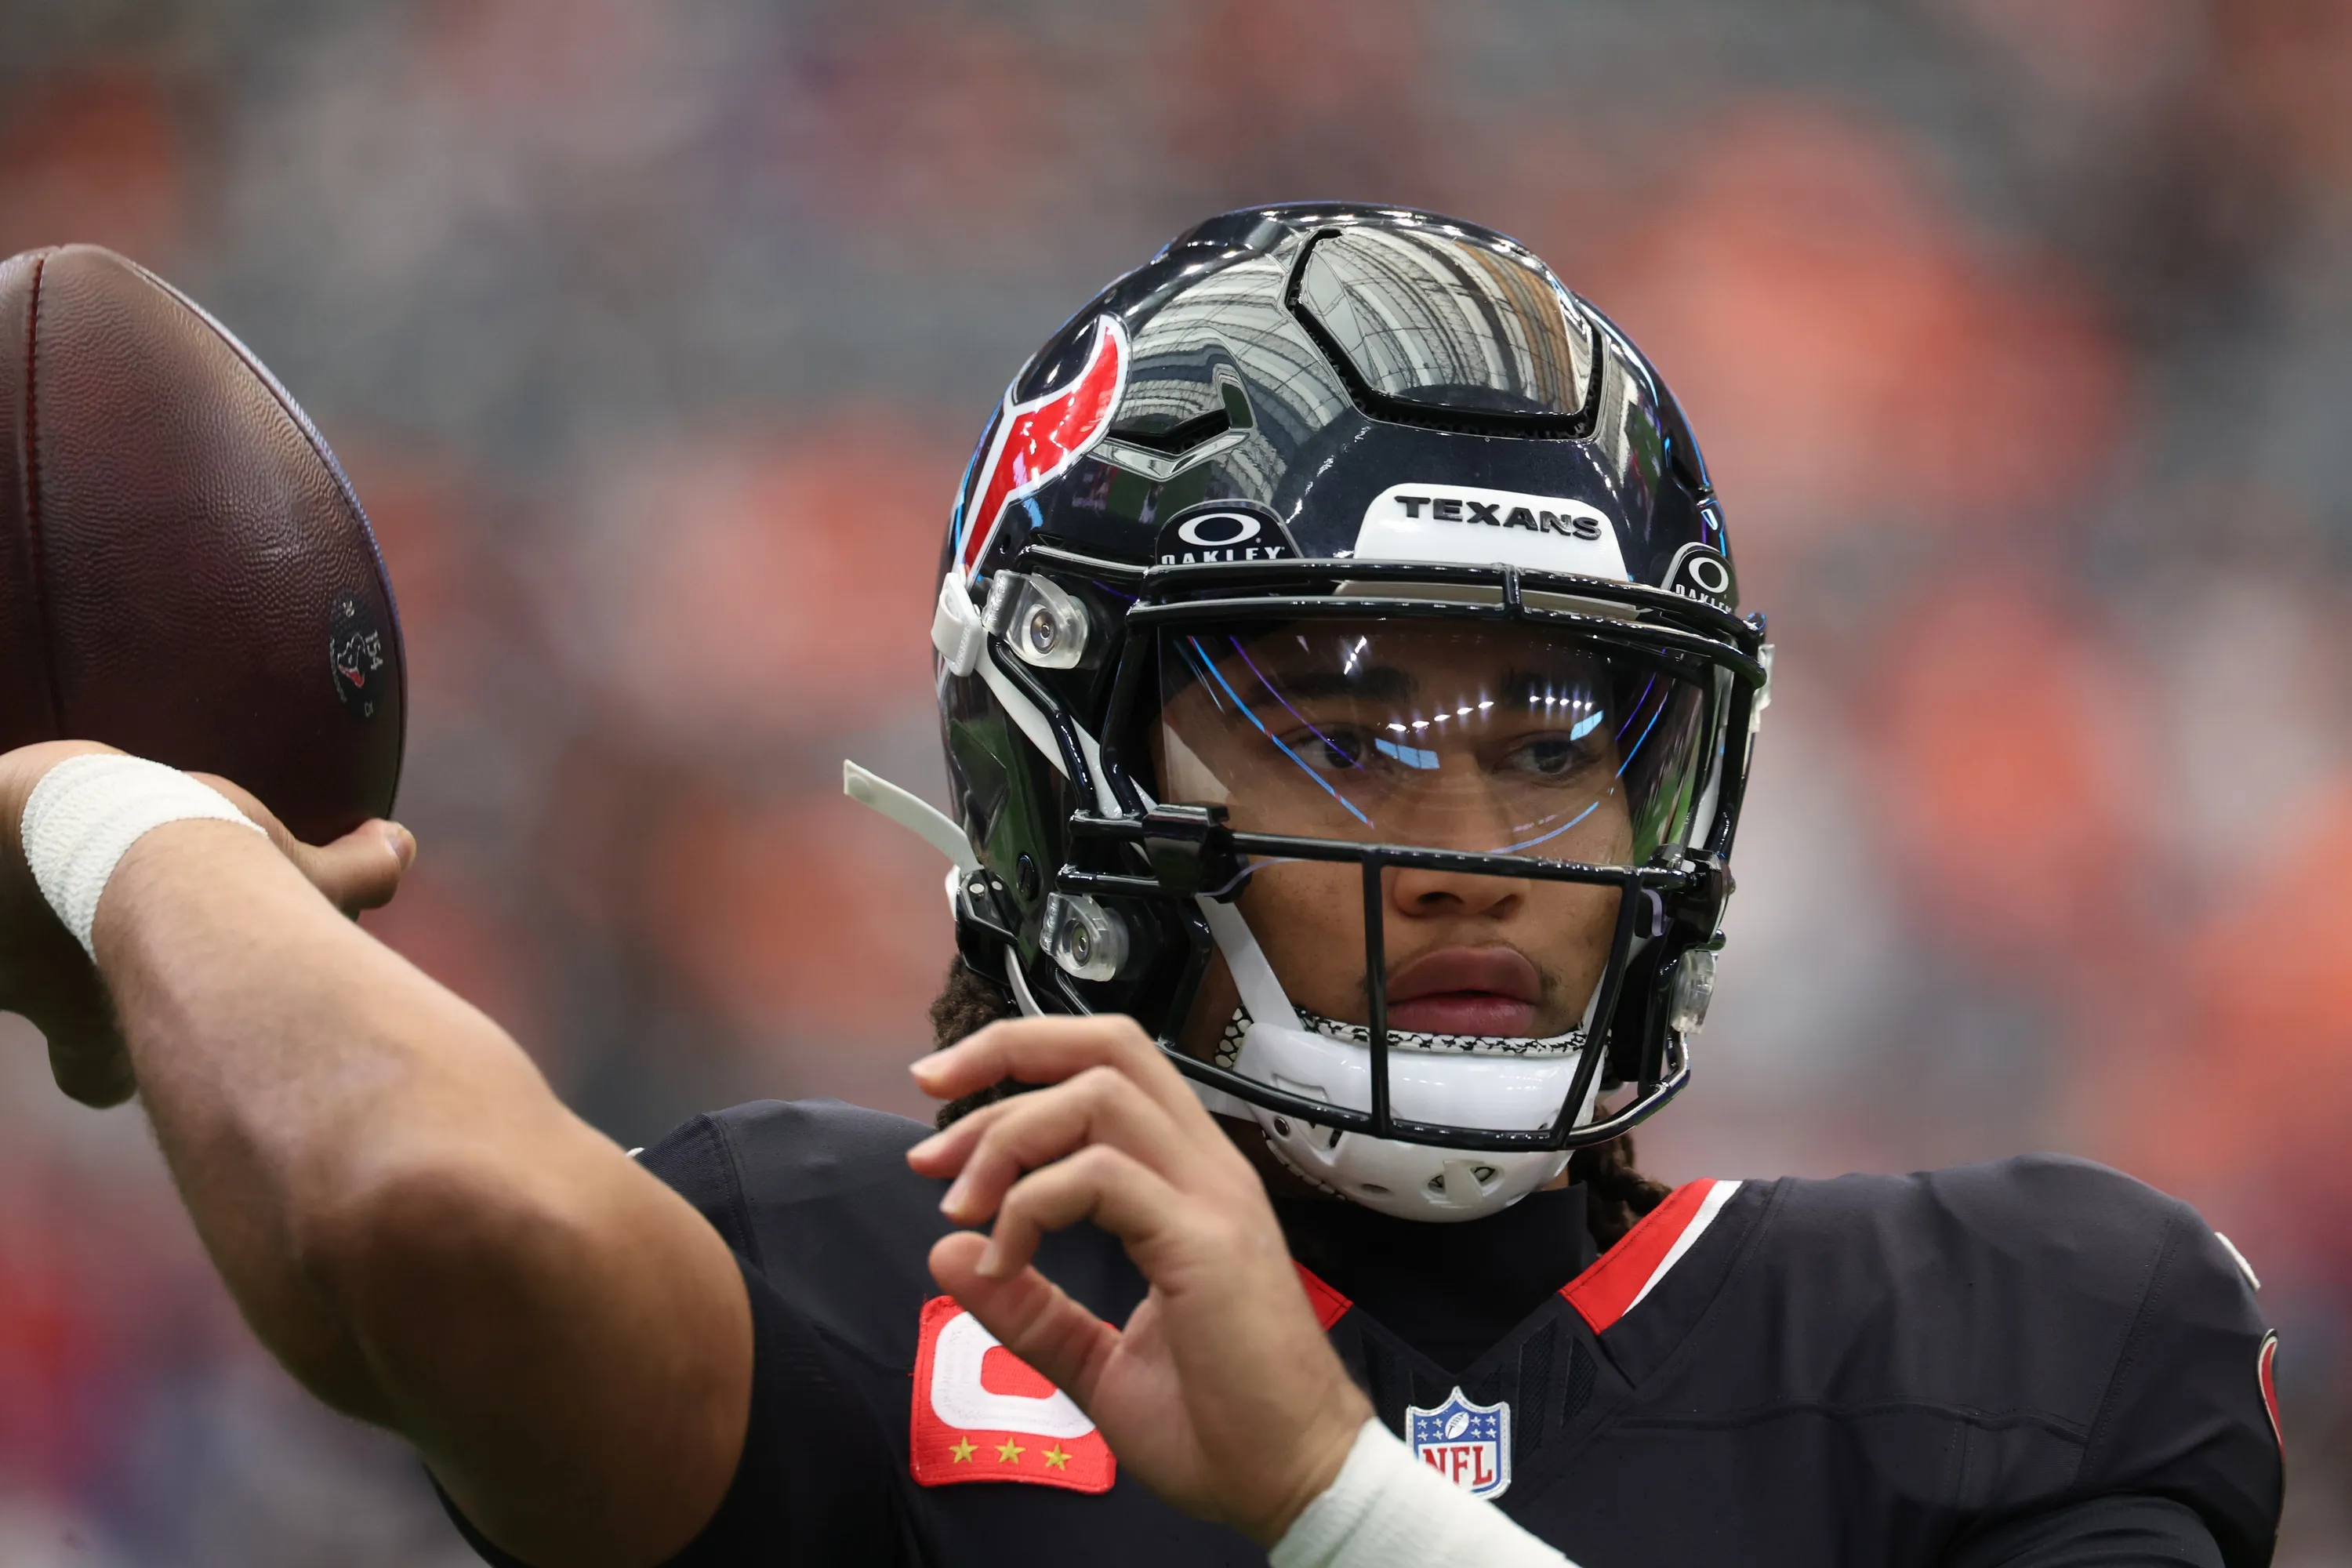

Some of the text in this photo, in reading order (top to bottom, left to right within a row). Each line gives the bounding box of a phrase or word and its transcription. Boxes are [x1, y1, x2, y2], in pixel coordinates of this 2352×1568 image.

[1394, 495, 1602, 540] TEXANS
[1161, 546, 1281, 565] OAKLEY
[365, 630, 383, 671] 154
[1423, 1446, 1492, 1486] NFL
